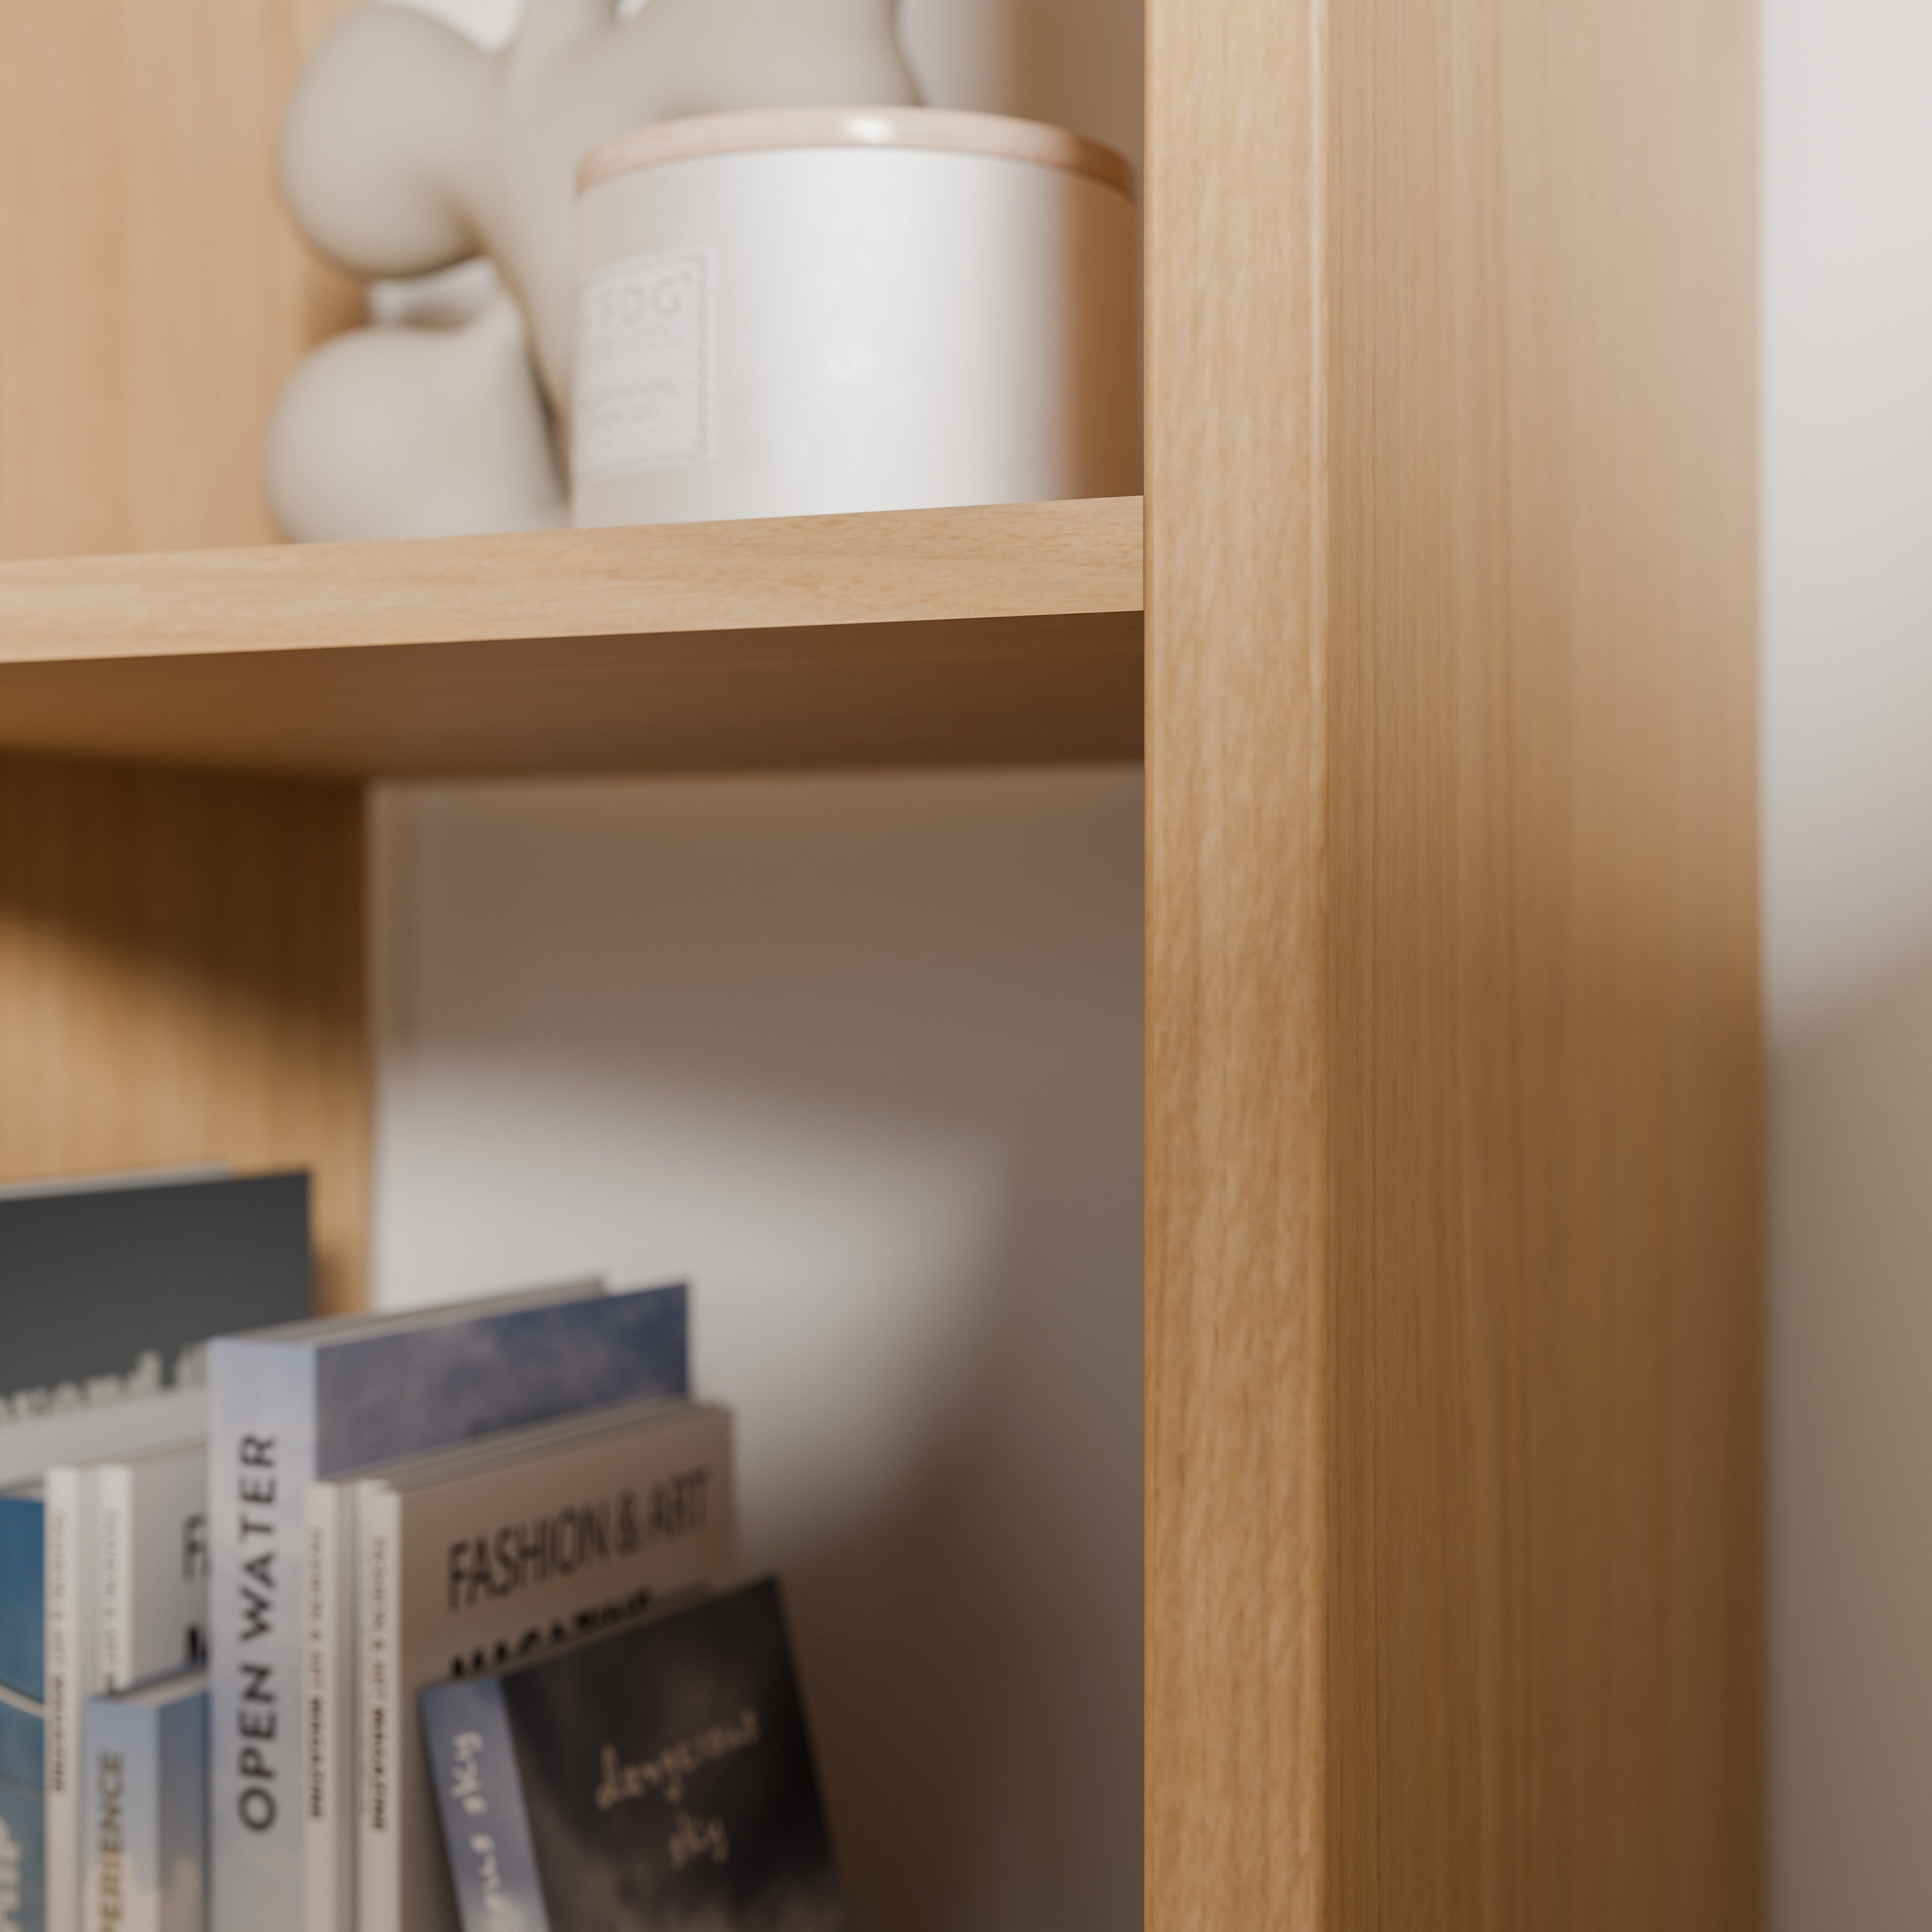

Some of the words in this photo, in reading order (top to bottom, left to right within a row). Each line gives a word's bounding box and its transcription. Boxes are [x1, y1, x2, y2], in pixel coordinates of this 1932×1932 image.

[237, 1432, 277, 1643] WATER
[448, 1497, 612, 1611] FASHION
[614, 1486, 645, 1558] &
[648, 1465, 711, 1539] ART
[237, 1662, 278, 1835] OPEN
[667, 1808, 730, 1870] sky
